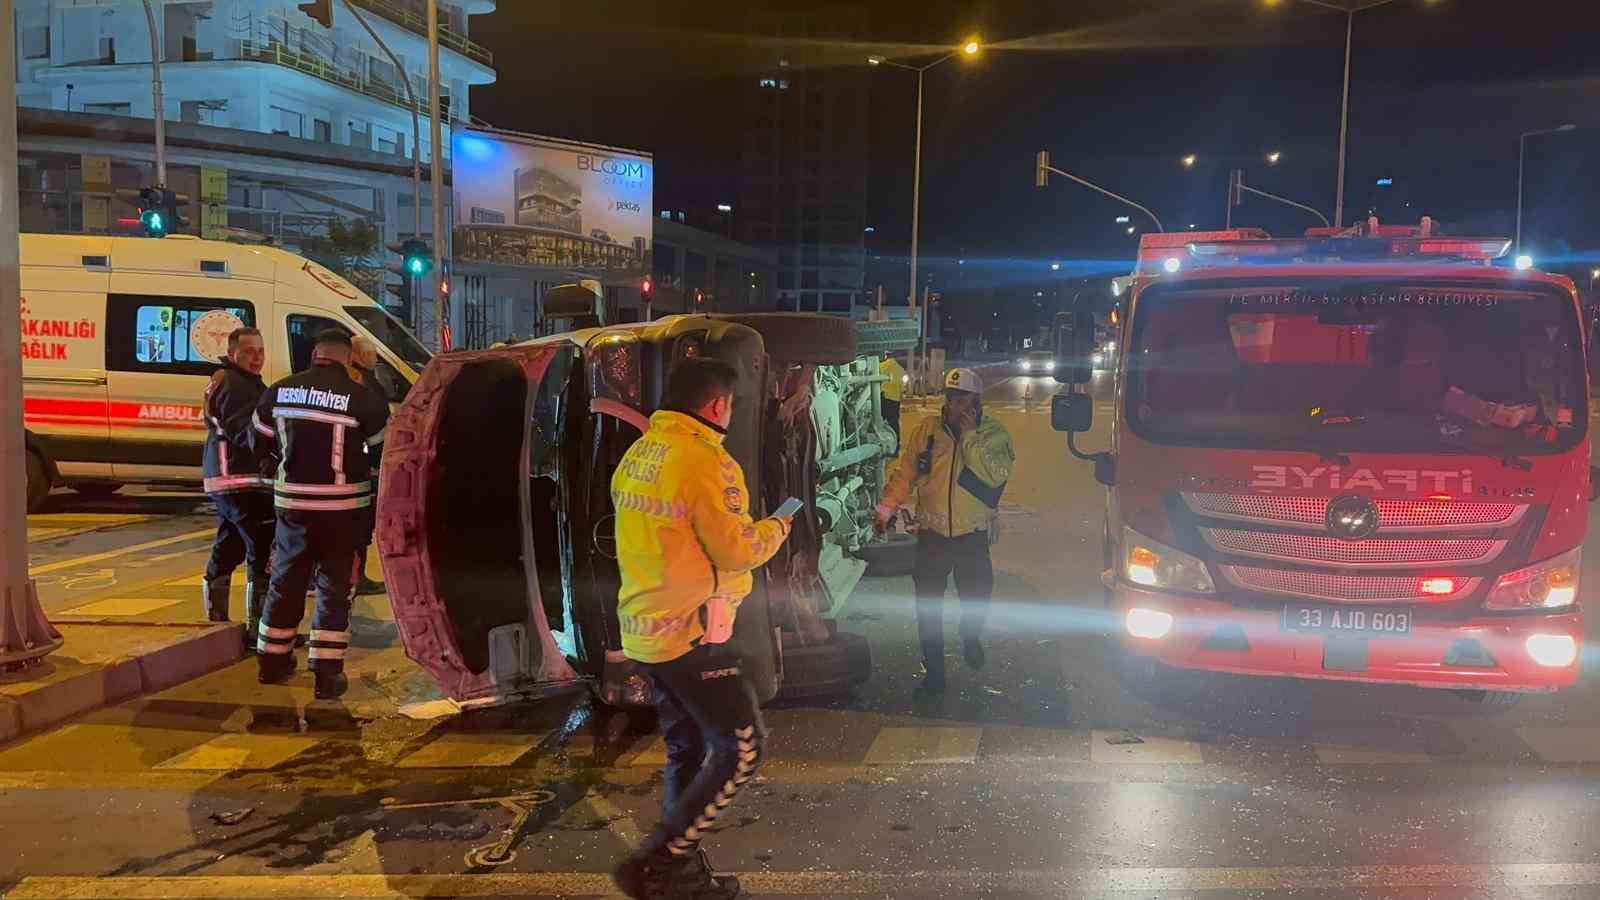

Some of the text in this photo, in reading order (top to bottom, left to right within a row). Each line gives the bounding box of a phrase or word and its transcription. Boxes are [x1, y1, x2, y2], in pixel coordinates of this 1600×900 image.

[577, 155, 643, 178] BLOOM
[277, 386, 309, 405] MERSİN
[1300, 608, 1408, 632] 33 AJD 603
